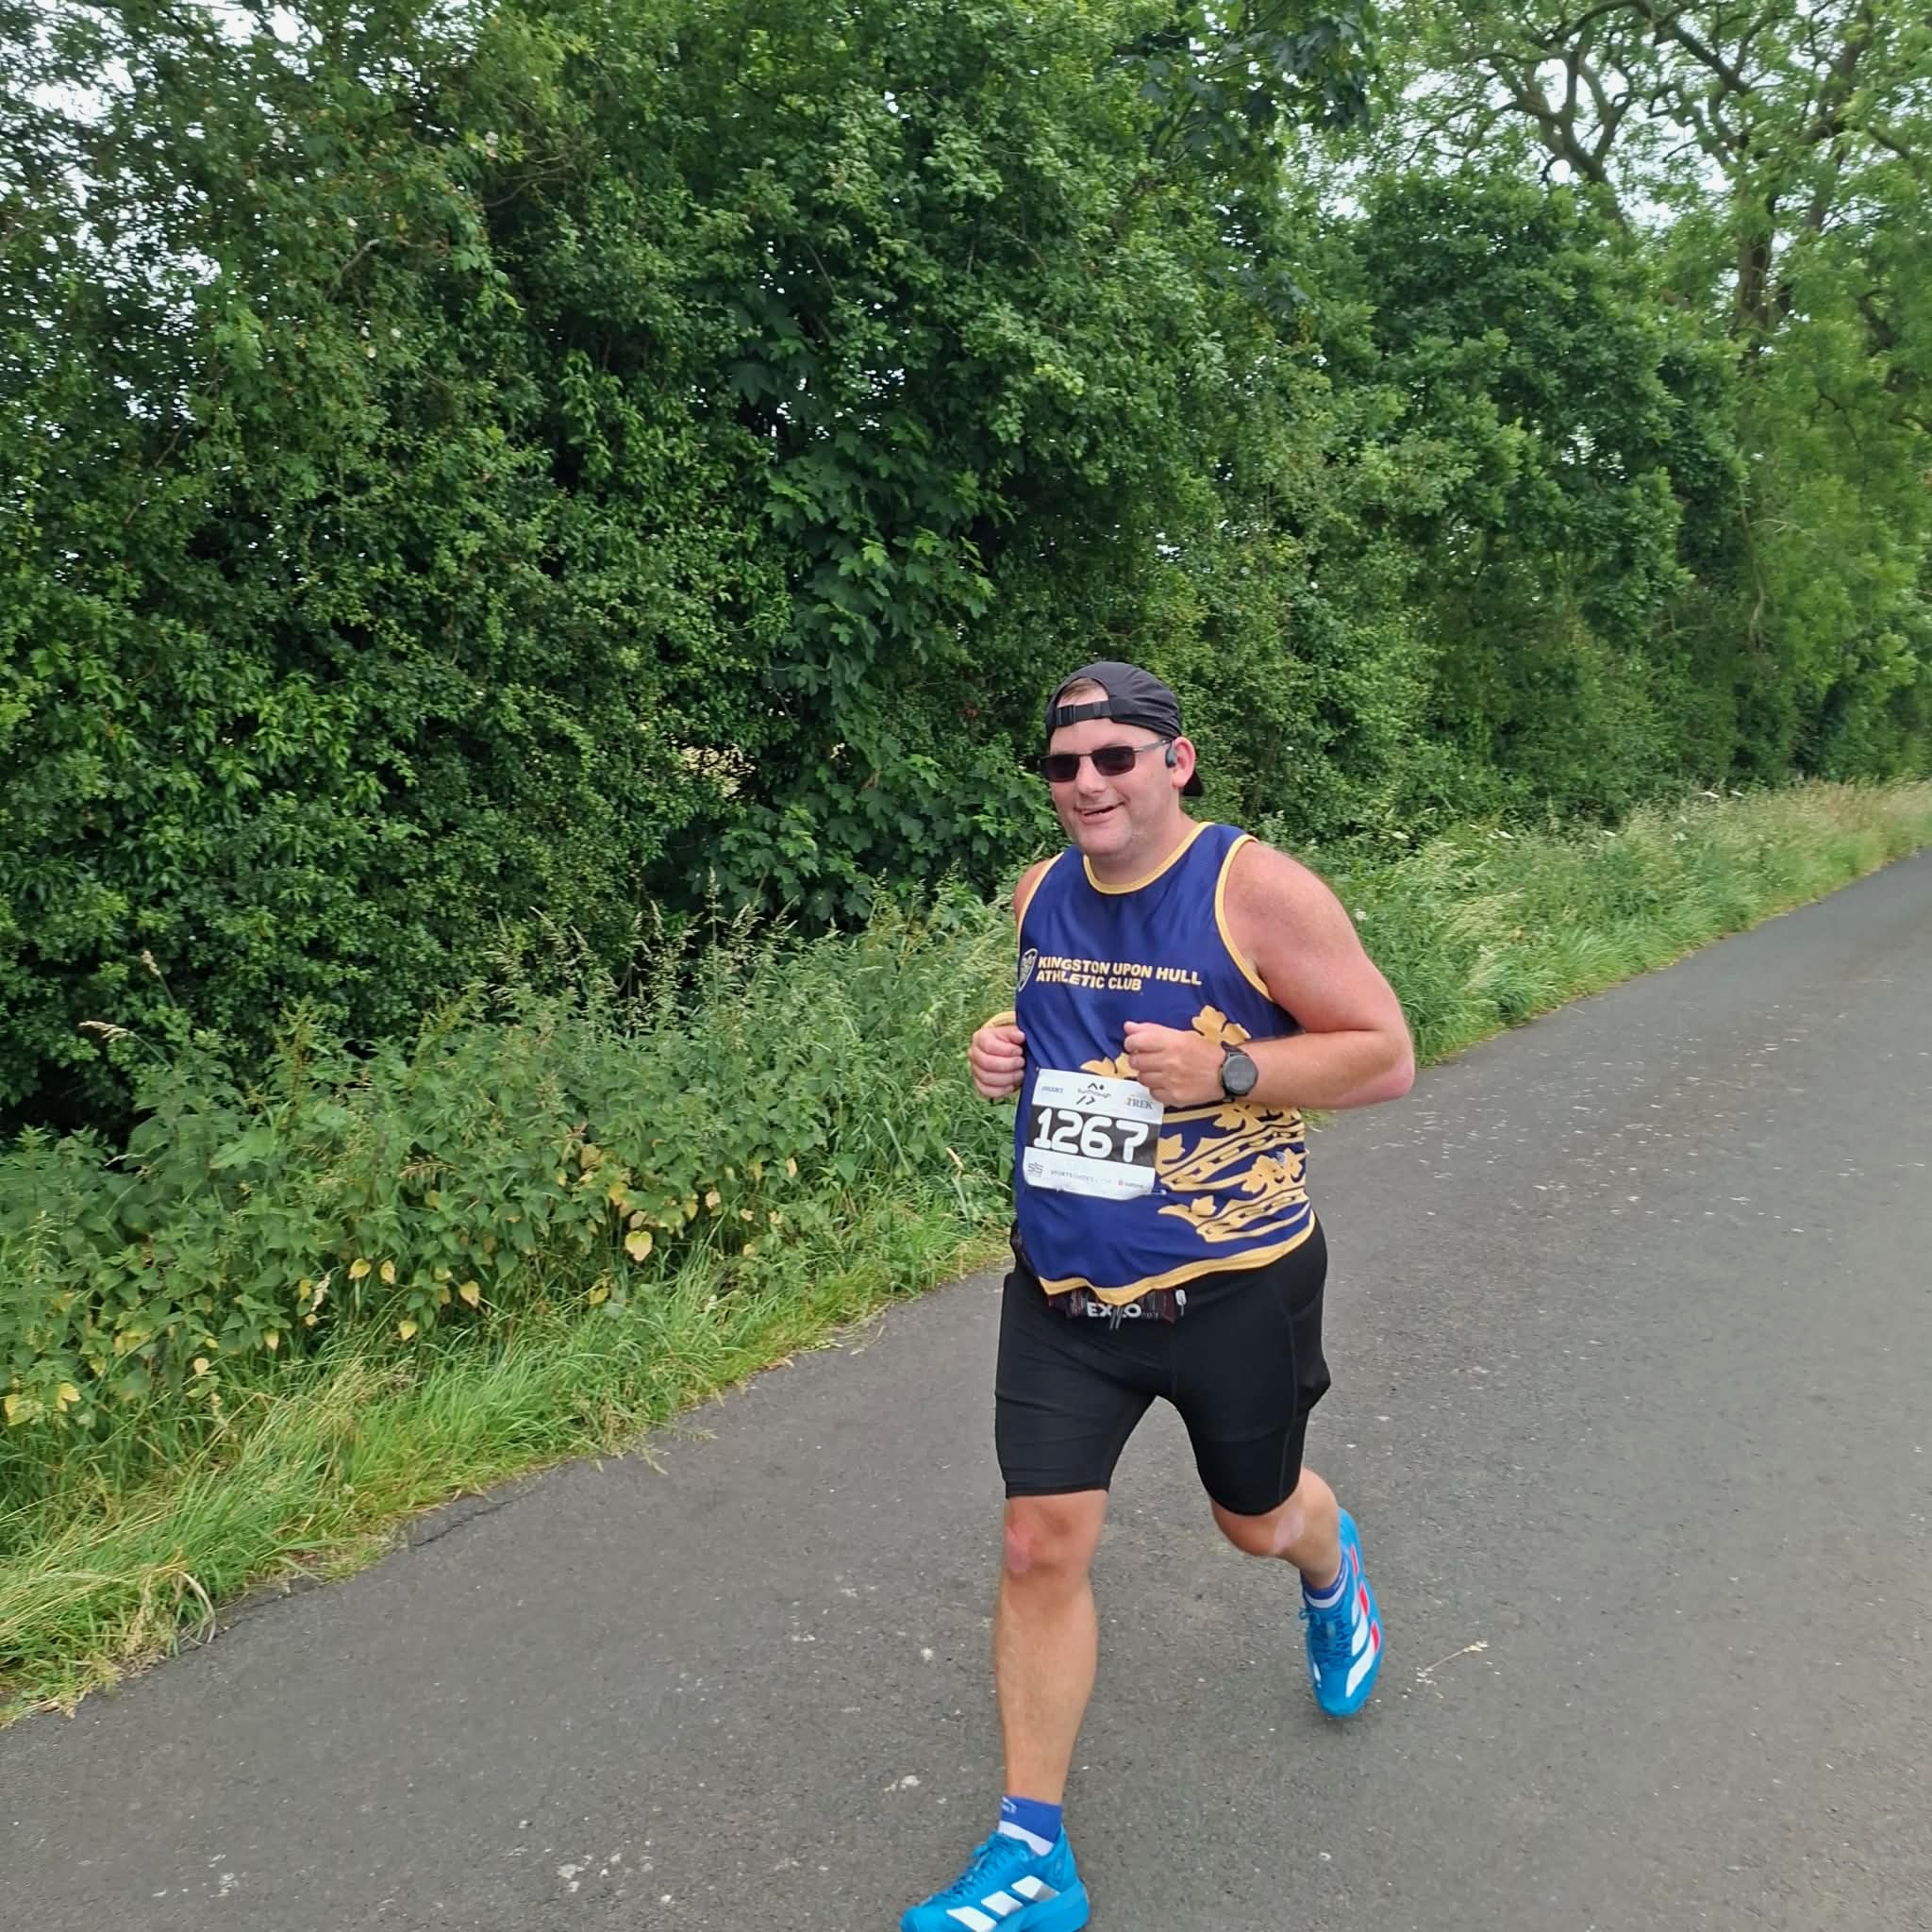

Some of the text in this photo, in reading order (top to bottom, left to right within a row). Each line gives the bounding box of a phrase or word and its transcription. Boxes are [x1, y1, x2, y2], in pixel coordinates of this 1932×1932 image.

[1036, 970, 1142, 991] ATHLETIC CLUB
[1038, 957, 1203, 986] KINGSTON UPON HULL
[1033, 1108, 1149, 1162] 1267
